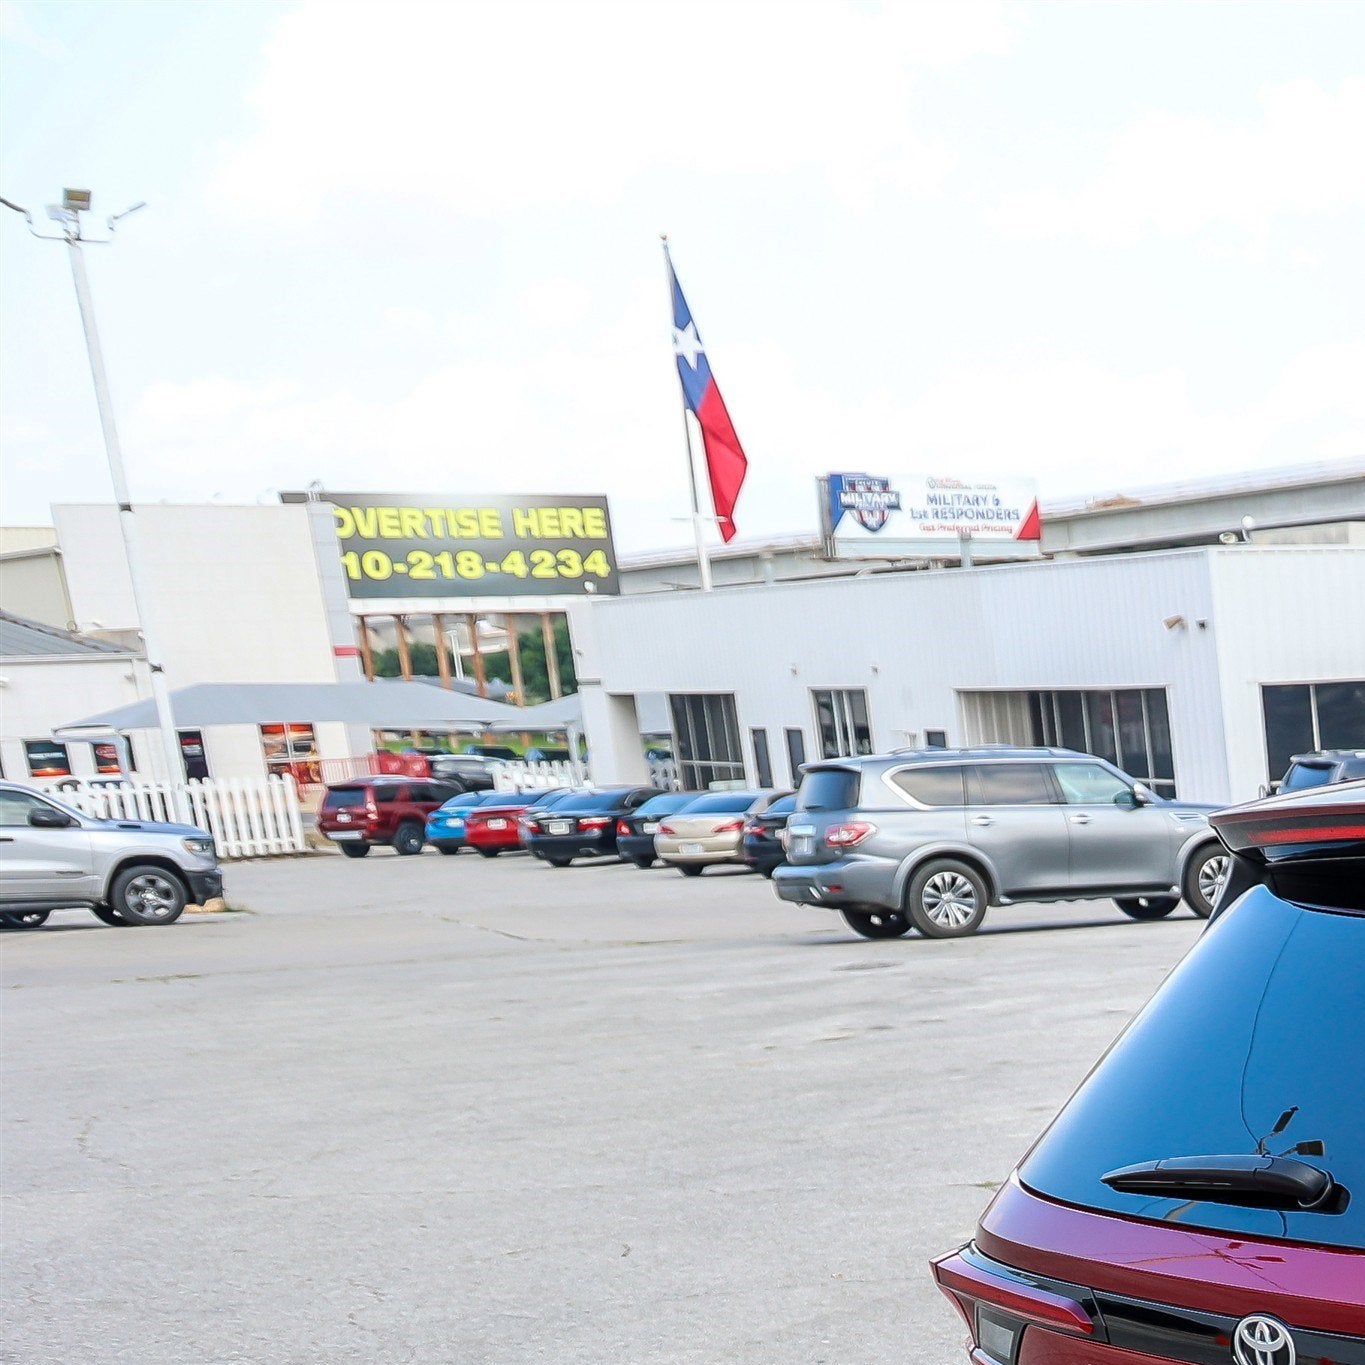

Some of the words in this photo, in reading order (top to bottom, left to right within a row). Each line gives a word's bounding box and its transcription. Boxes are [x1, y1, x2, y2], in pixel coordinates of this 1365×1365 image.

[926, 493, 988, 506] MILITARY
[332, 507, 503, 539] DVERTISE
[512, 507, 607, 539] HERE
[932, 508, 1020, 521] RESPONDERS
[341, 549, 611, 580] 10-218-4234
